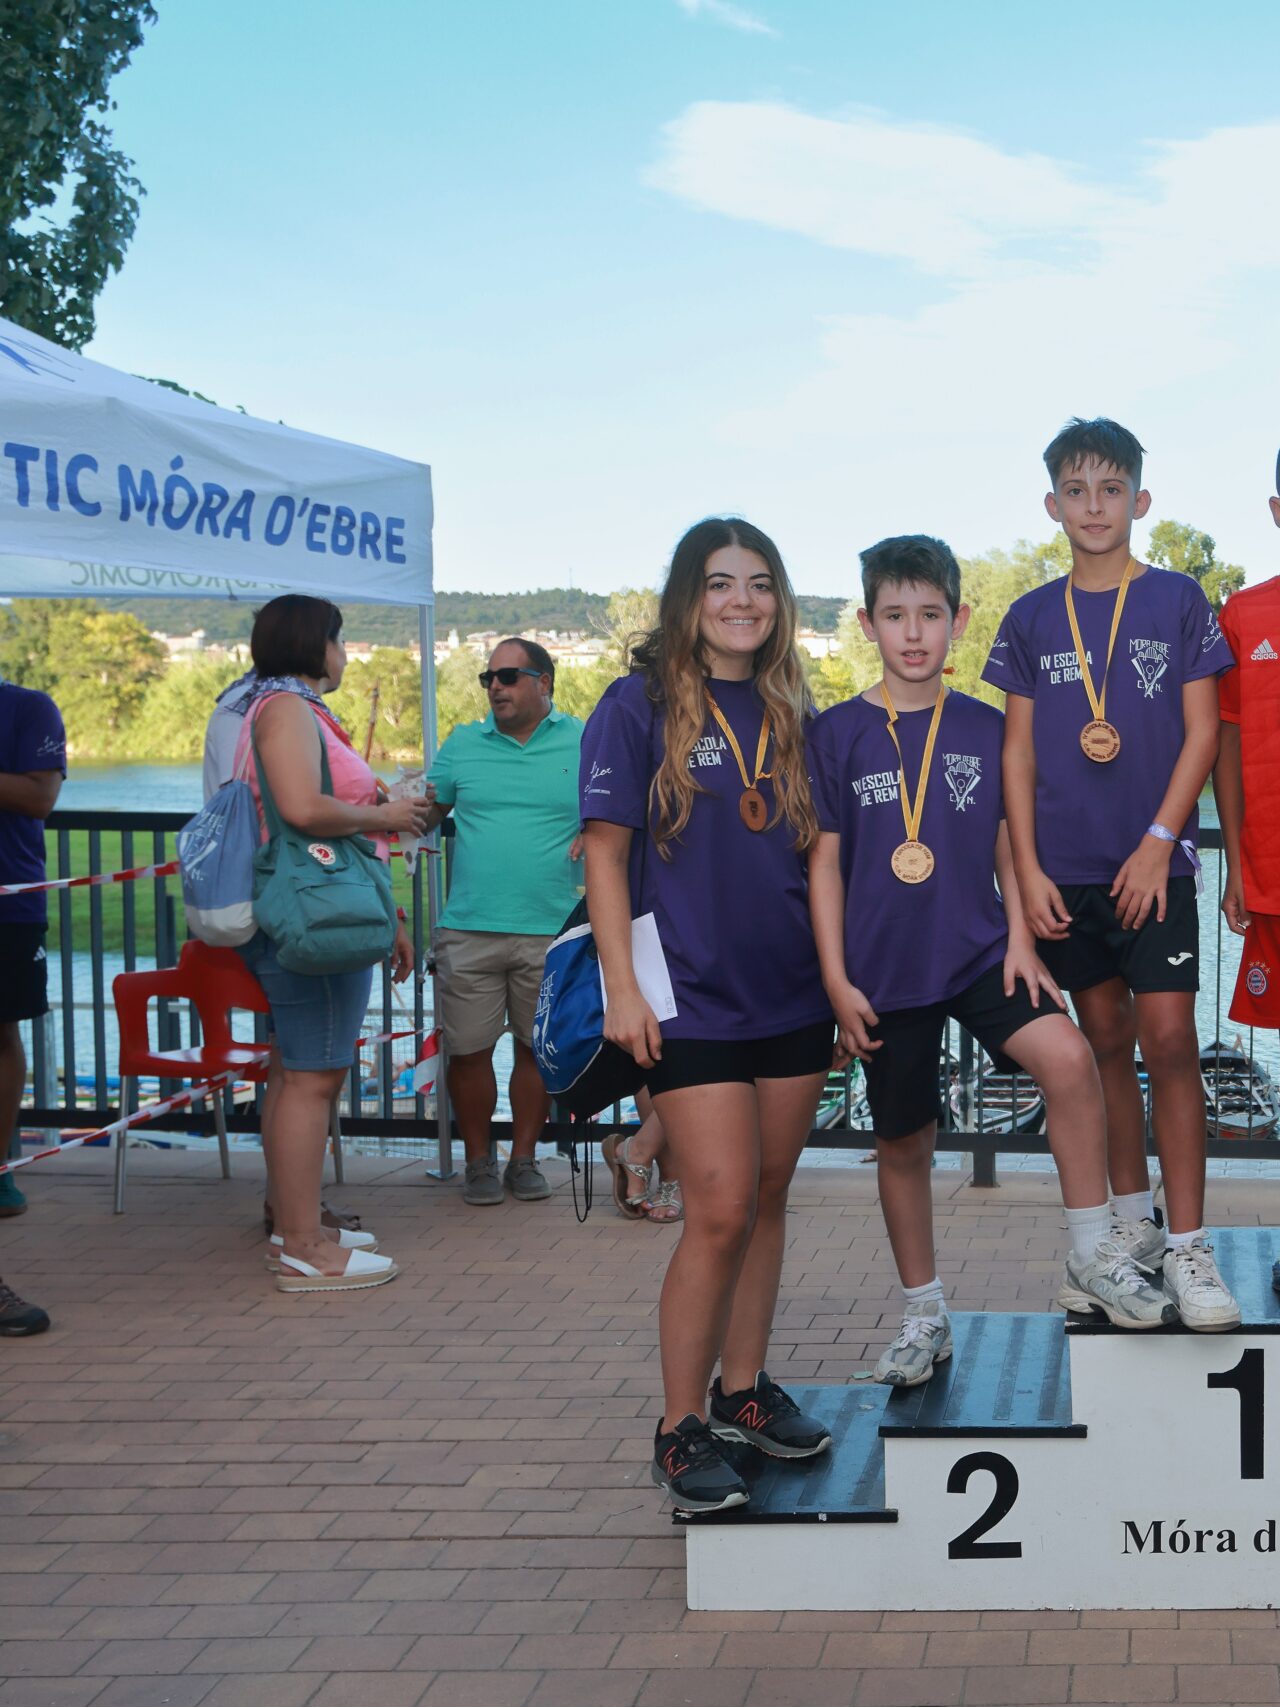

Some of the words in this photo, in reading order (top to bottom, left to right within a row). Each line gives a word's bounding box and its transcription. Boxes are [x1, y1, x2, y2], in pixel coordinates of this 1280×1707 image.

[117, 455, 256, 542] MÓRA
[264, 496, 407, 565] D'EBRE
[1040, 655, 1051, 669] IV
[1054, 651, 1093, 668] ESCOA
[1250, 652, 1279, 660] adidas
[1050, 671, 1061, 684] DE
[1063, 666, 1083, 682] REM
[697, 752, 722, 767] REM
[861, 793, 872, 806] DE
[874, 786, 899, 803] REM
[1208, 1349, 1264, 1479] 1
[946, 1451, 1022, 1559] 2
[1121, 1519, 1238, 1554] Móra
